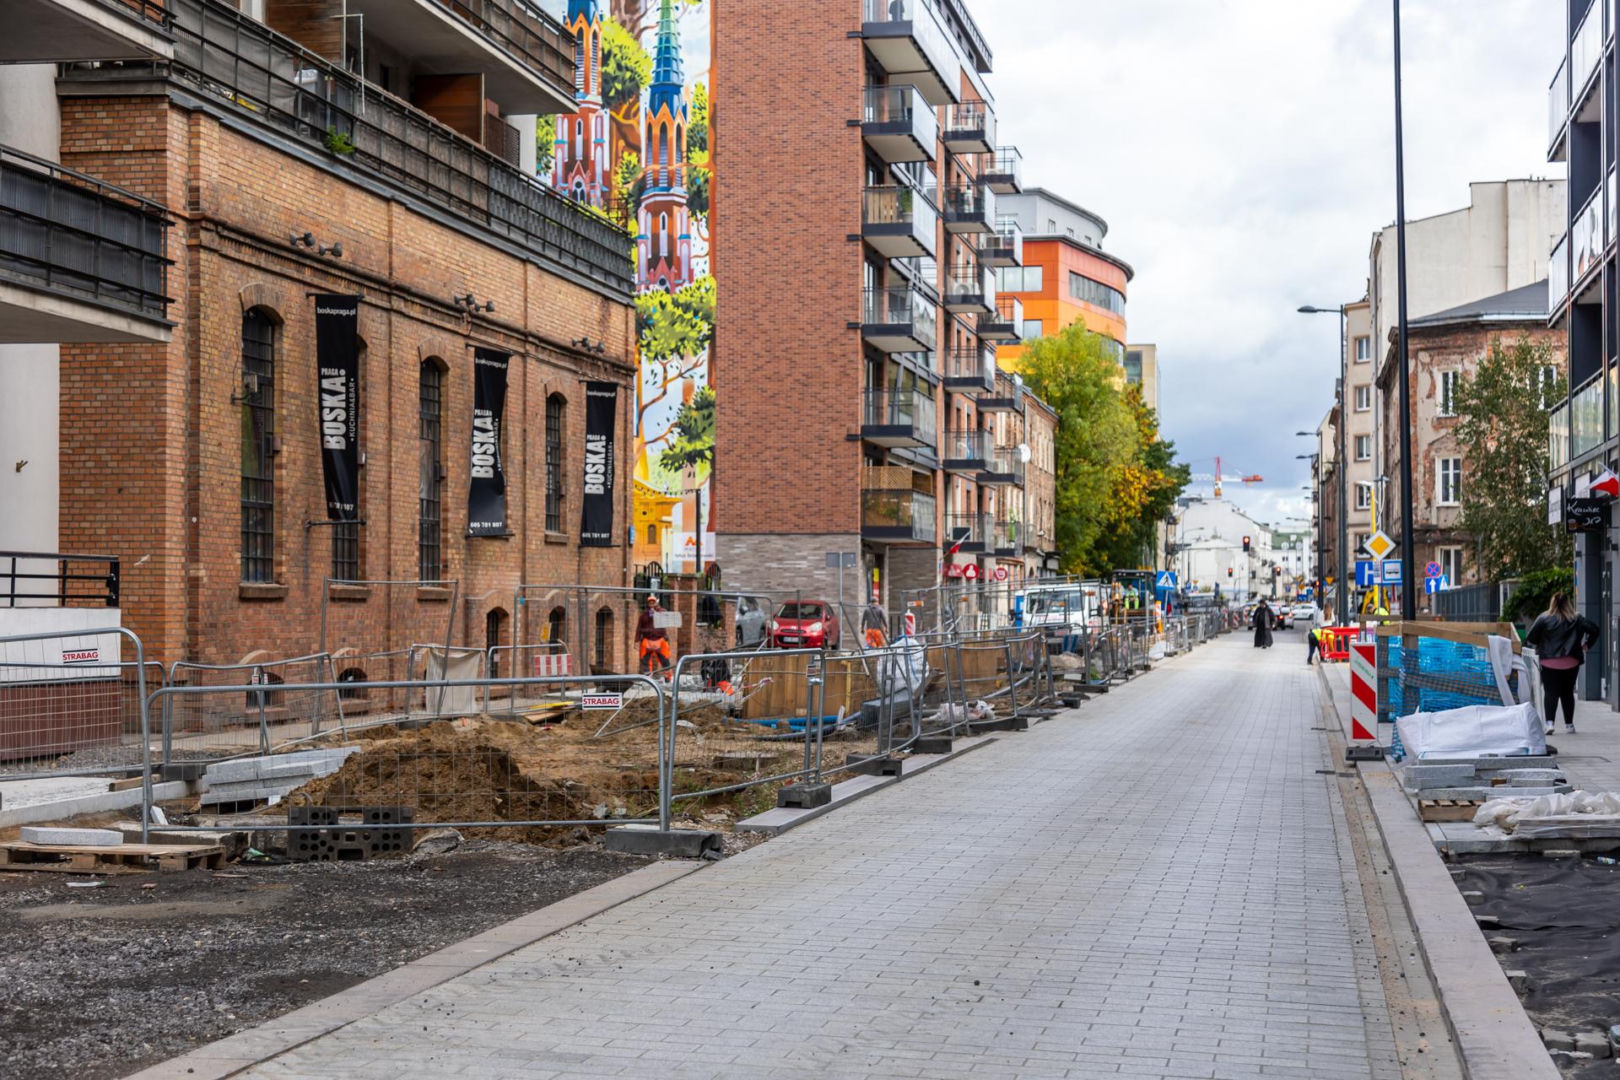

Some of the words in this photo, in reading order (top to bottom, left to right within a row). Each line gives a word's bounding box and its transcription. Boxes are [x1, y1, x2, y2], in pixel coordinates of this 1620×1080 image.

[317, 307, 356, 316] boskapraga.pl
[321, 367, 338, 376] PRAGA
[321, 376, 347, 450] BOSKA
[471, 415, 496, 478] BOSKA
[584, 440, 607, 495] BOSKA
[62, 651, 99, 661] STRABAG
